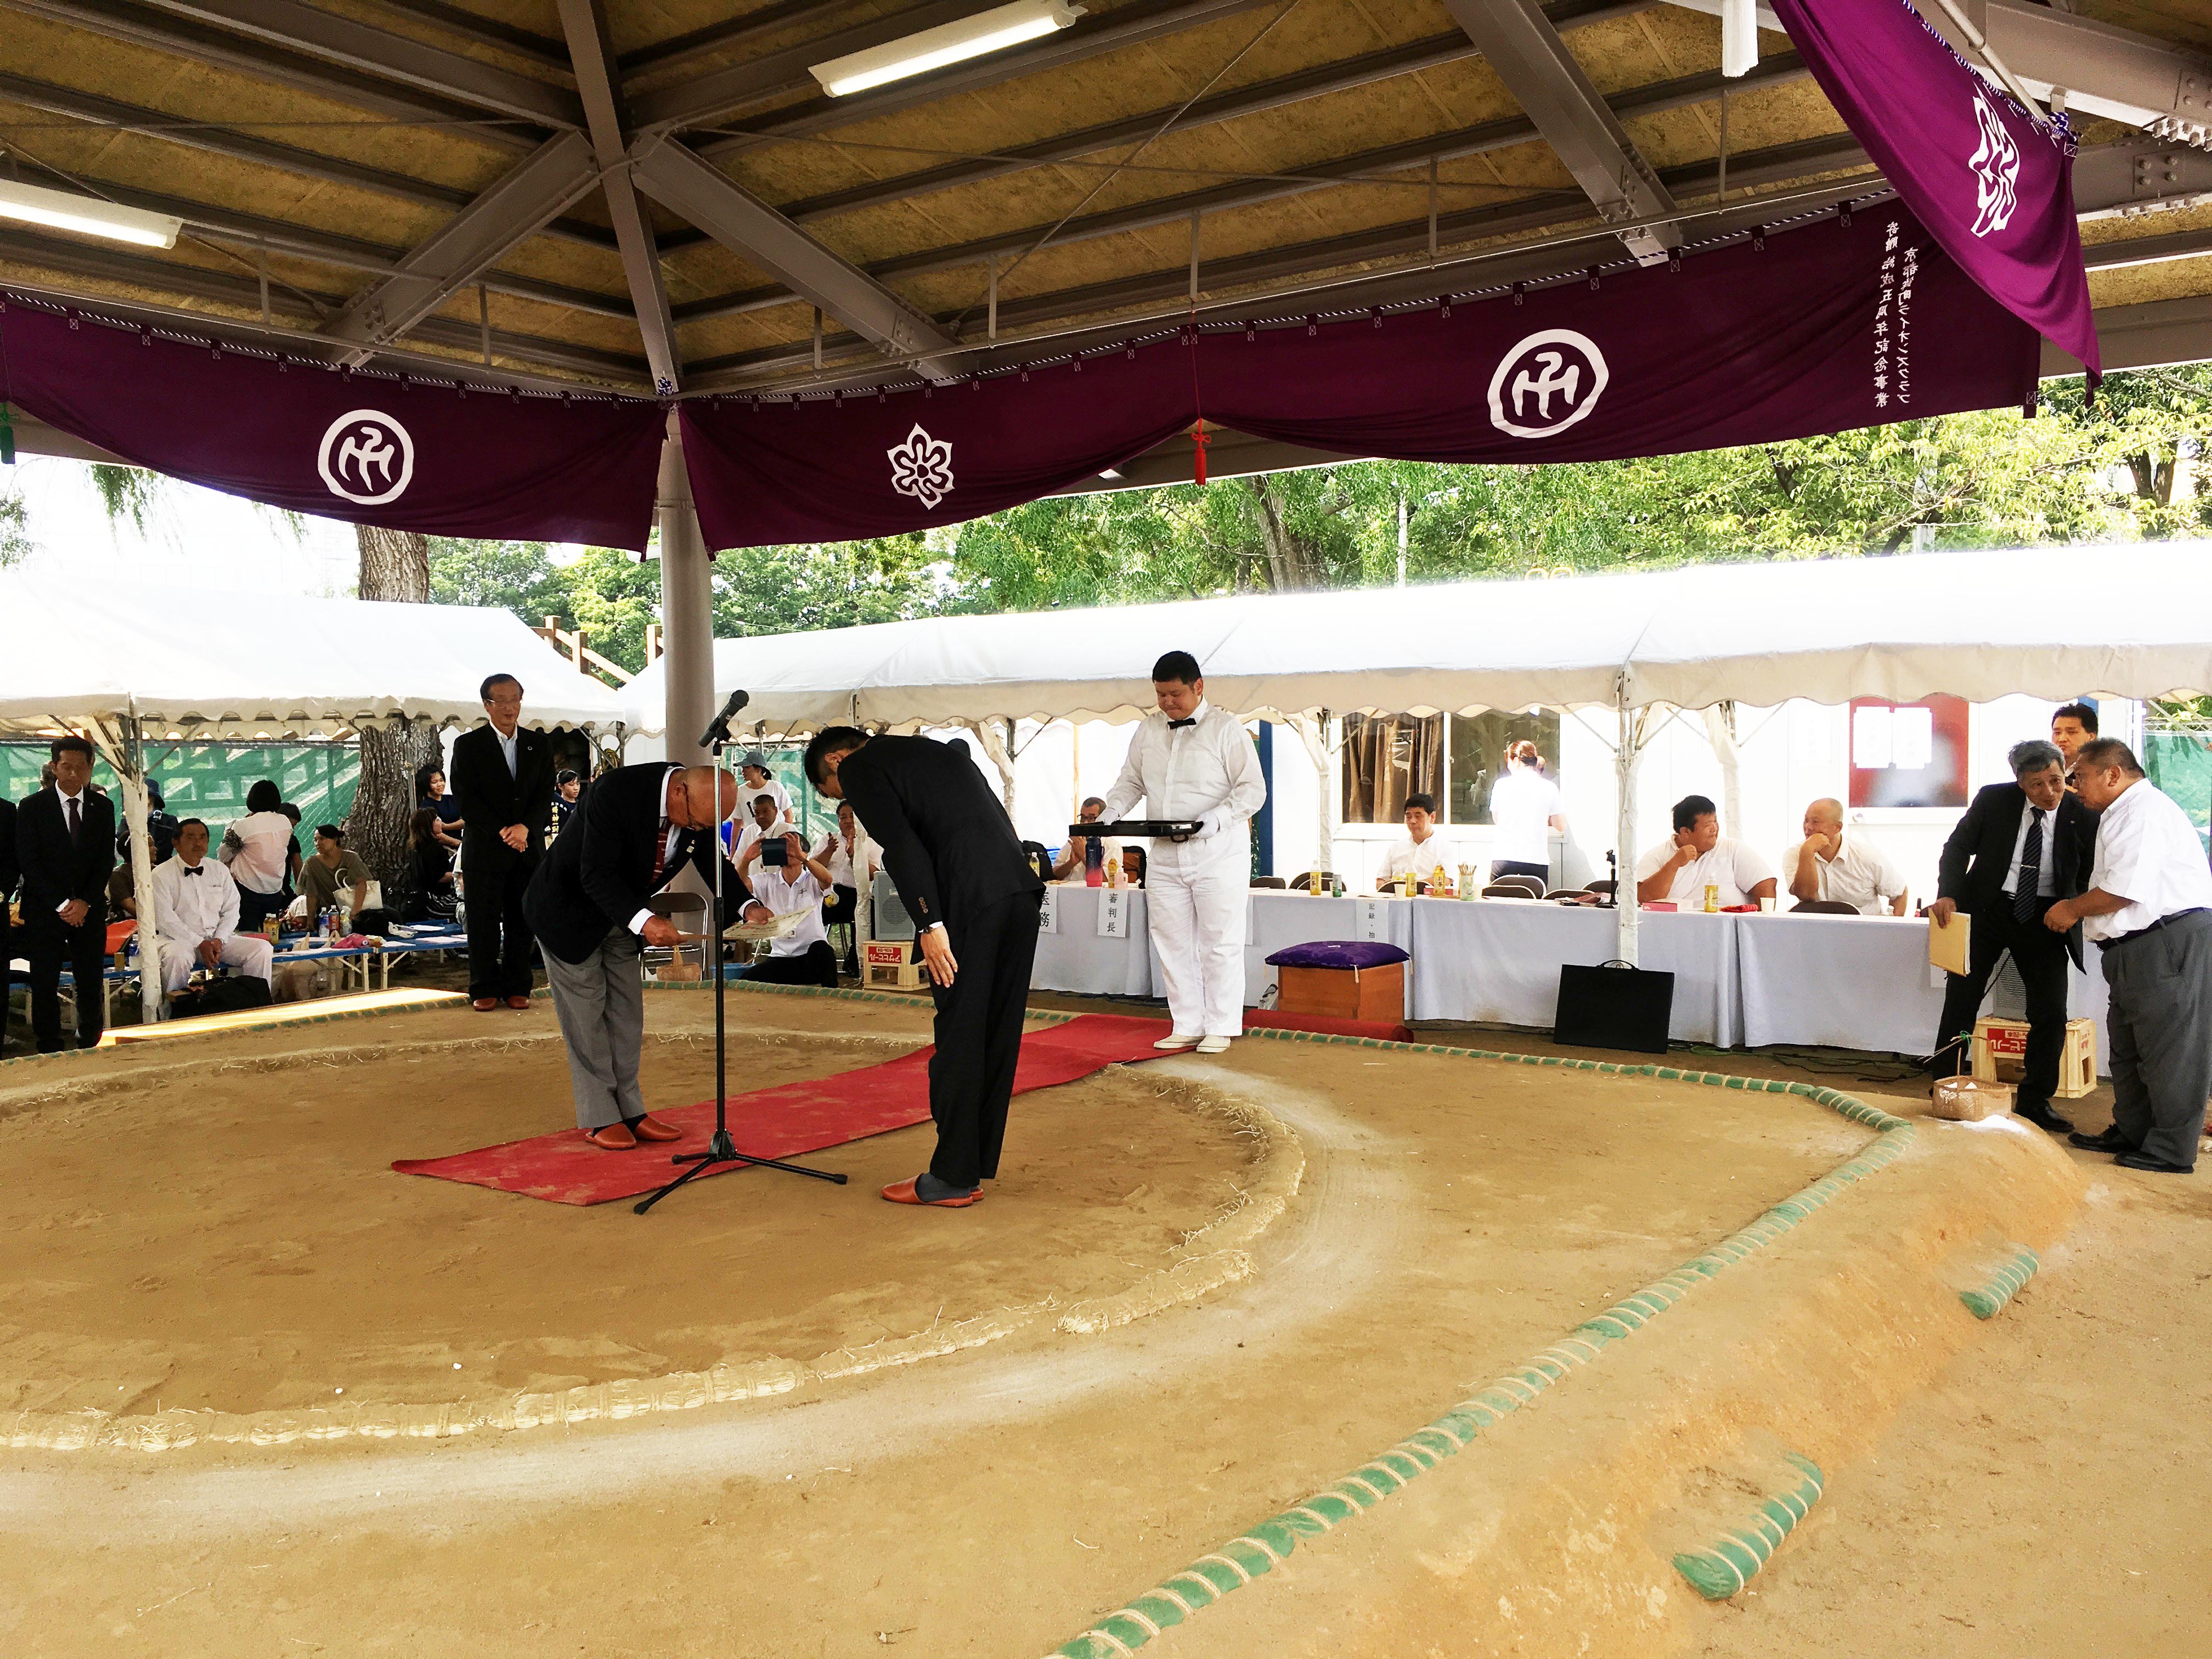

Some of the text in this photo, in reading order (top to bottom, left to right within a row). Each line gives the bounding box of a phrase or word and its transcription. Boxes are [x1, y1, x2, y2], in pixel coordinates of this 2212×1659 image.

[1107, 893, 1118, 932] 審判長
[870, 953, 900, 962] アサヒビール
